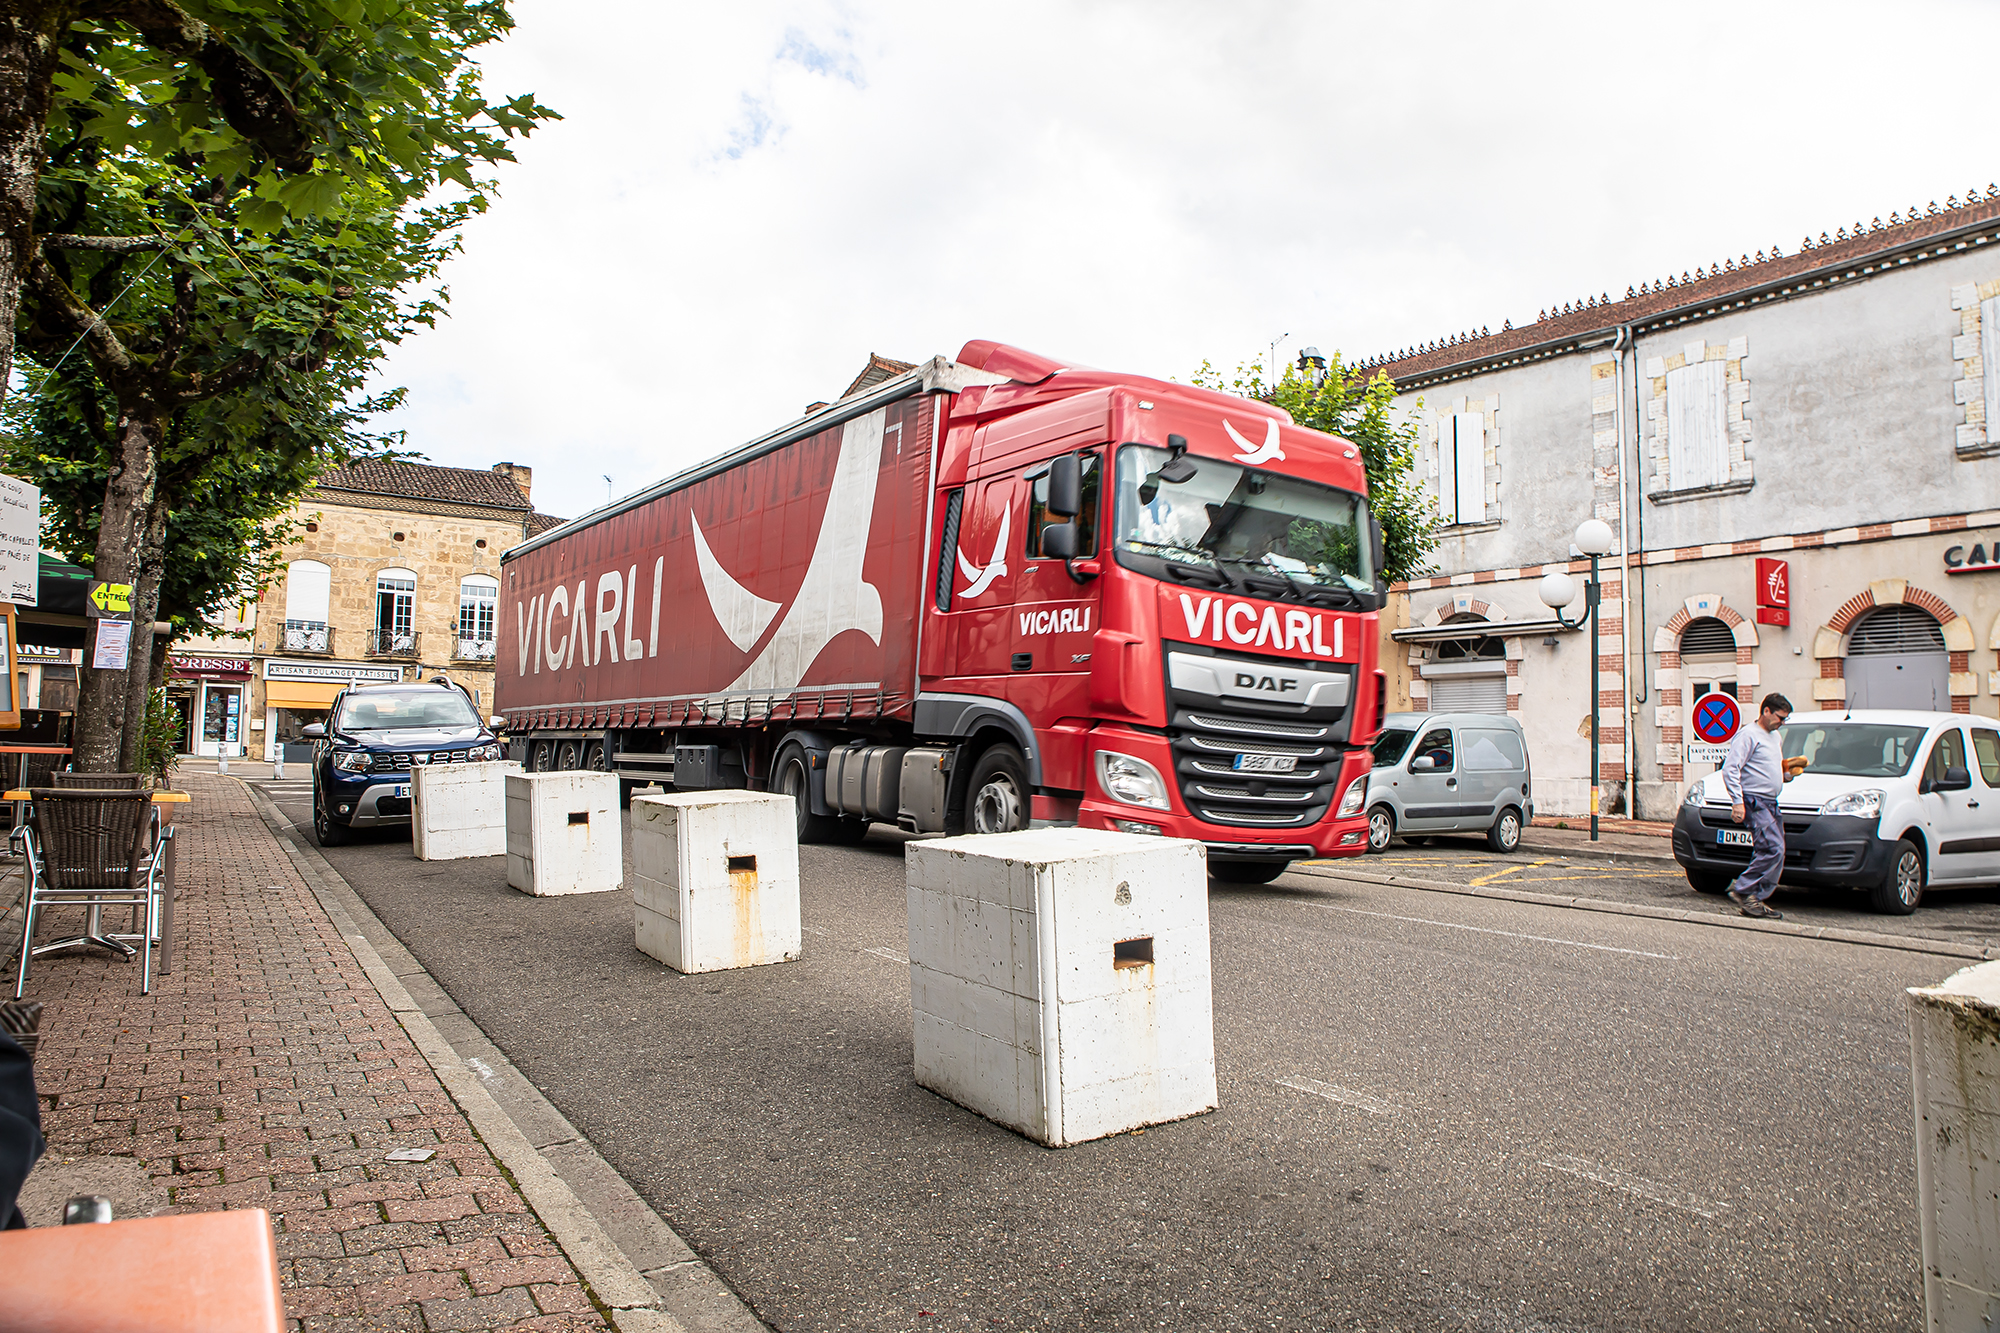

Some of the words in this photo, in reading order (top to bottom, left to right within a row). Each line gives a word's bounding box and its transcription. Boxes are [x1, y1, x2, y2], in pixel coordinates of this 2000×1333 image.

[97, 592, 127, 602] ENTRÉE
[518, 555, 664, 677] VICARLI
[1019, 606, 1091, 636] VICARLI
[1179, 593, 1344, 658] VICARLI
[172, 657, 245, 671] PRESSE
[1070, 653, 1092, 664] XF
[269, 667, 304, 675] ARTISAN
[307, 668, 356, 677] BOULANGER
[359, 669, 398, 679] PÂTISSIER
[1234, 672, 1299, 692] DAF
